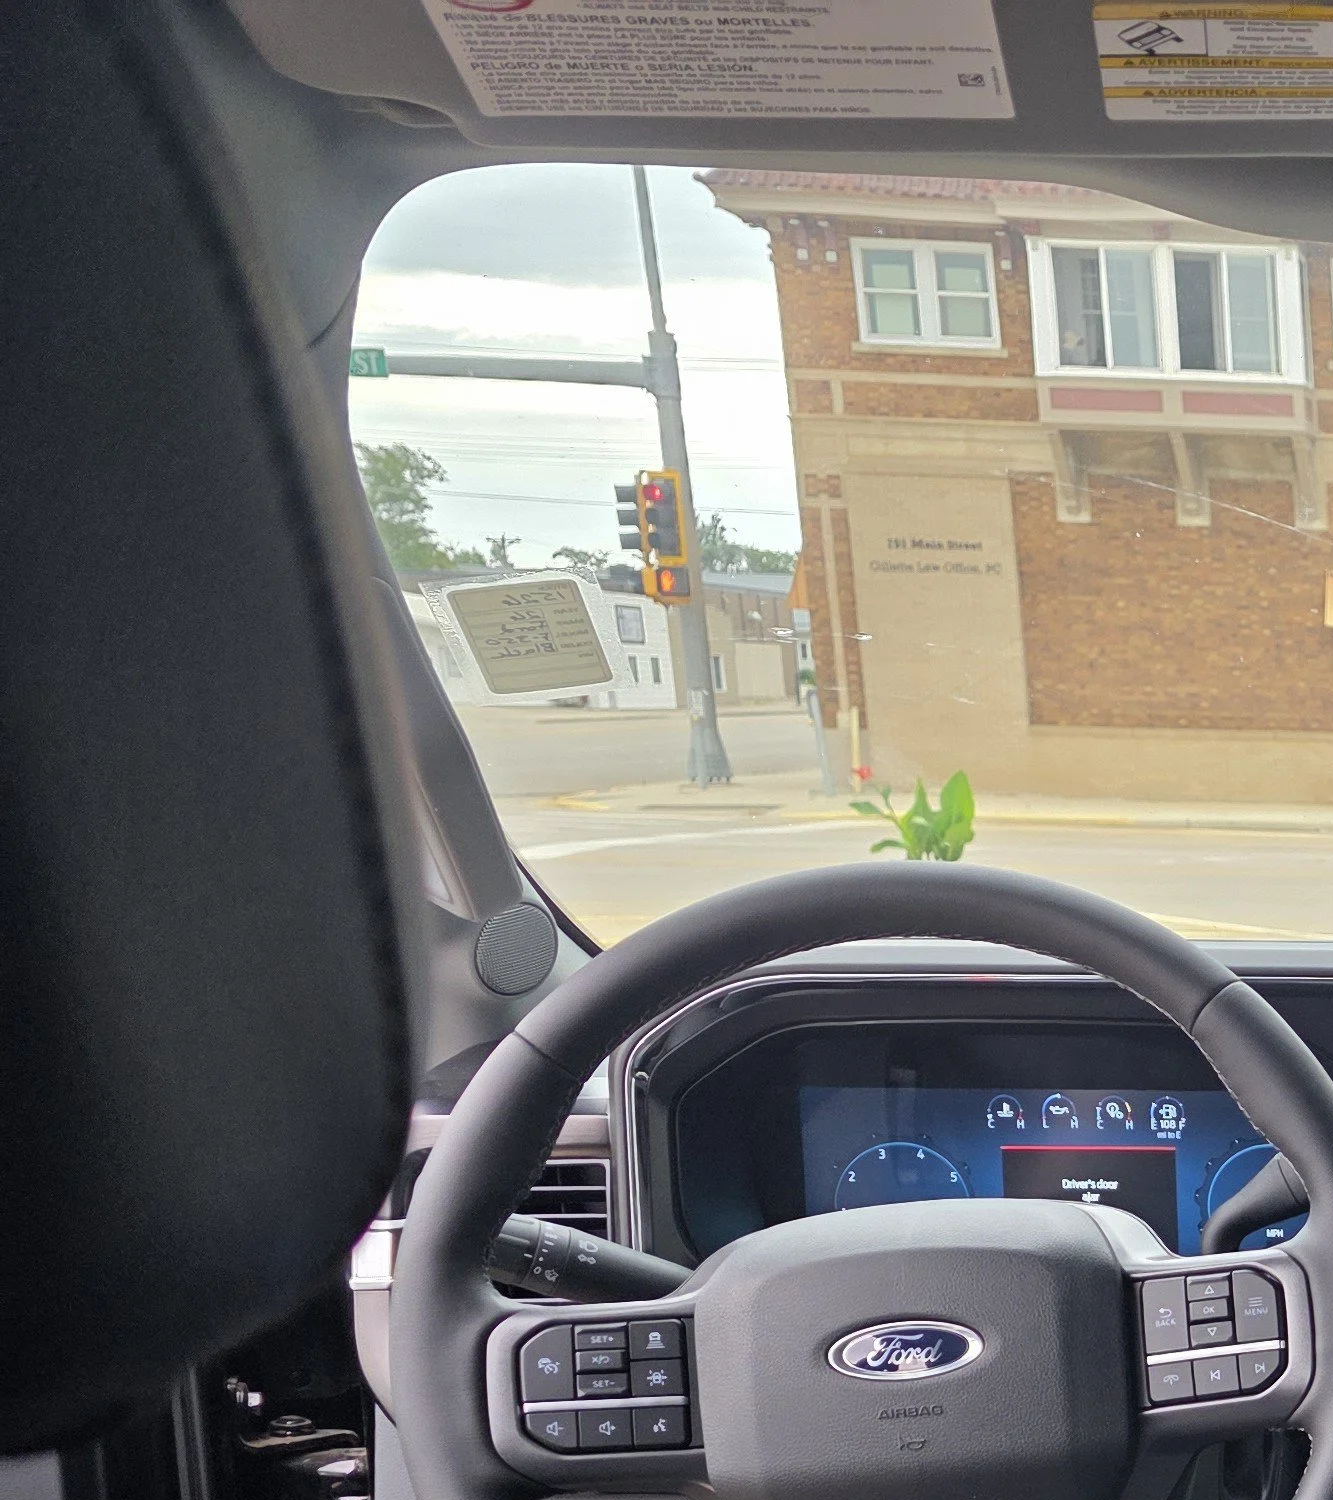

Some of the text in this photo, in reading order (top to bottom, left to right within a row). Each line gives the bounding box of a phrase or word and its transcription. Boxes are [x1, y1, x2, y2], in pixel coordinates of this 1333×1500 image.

[504, 14, 523, 22] de
[527, 13, 620, 24] BLESSURES
[626, 15, 689, 25] GRAVES
[695, 18, 713, 26] ou
[717, 17, 815, 27] MORTELLES.
[470, 61, 540, 71] PELIGRO
[544, 62, 562, 70] de
[566, 62, 630, 71] MUERTE
[649, 63, 691, 72] SERIA
[353, 351, 378, 375] ST
[988, 1119, 1025, 1129] C H
[1097, 1119, 1133, 1129] C H
[1151, 1119, 1186, 1130] E 108 F
[878, 1149, 886, 1160] 3
[917, 1149, 925, 1159] 4
[848, 1171, 856, 1182] 2
[950, 1171, 958, 1182] 5
[1061, 1179, 1118, 1190] Driver's door
[1082, 1192, 1100, 1203] ajar
[1266, 1229, 1284, 1238] MPH
[1202, 1306, 1215, 1315] OK
[1244, 1307, 1269, 1316] MENU
[1155, 1319, 1176, 1327] BACK
[865, 1333, 943, 1367] Ford
[878, 1405, 944, 1420] AIRBAG
